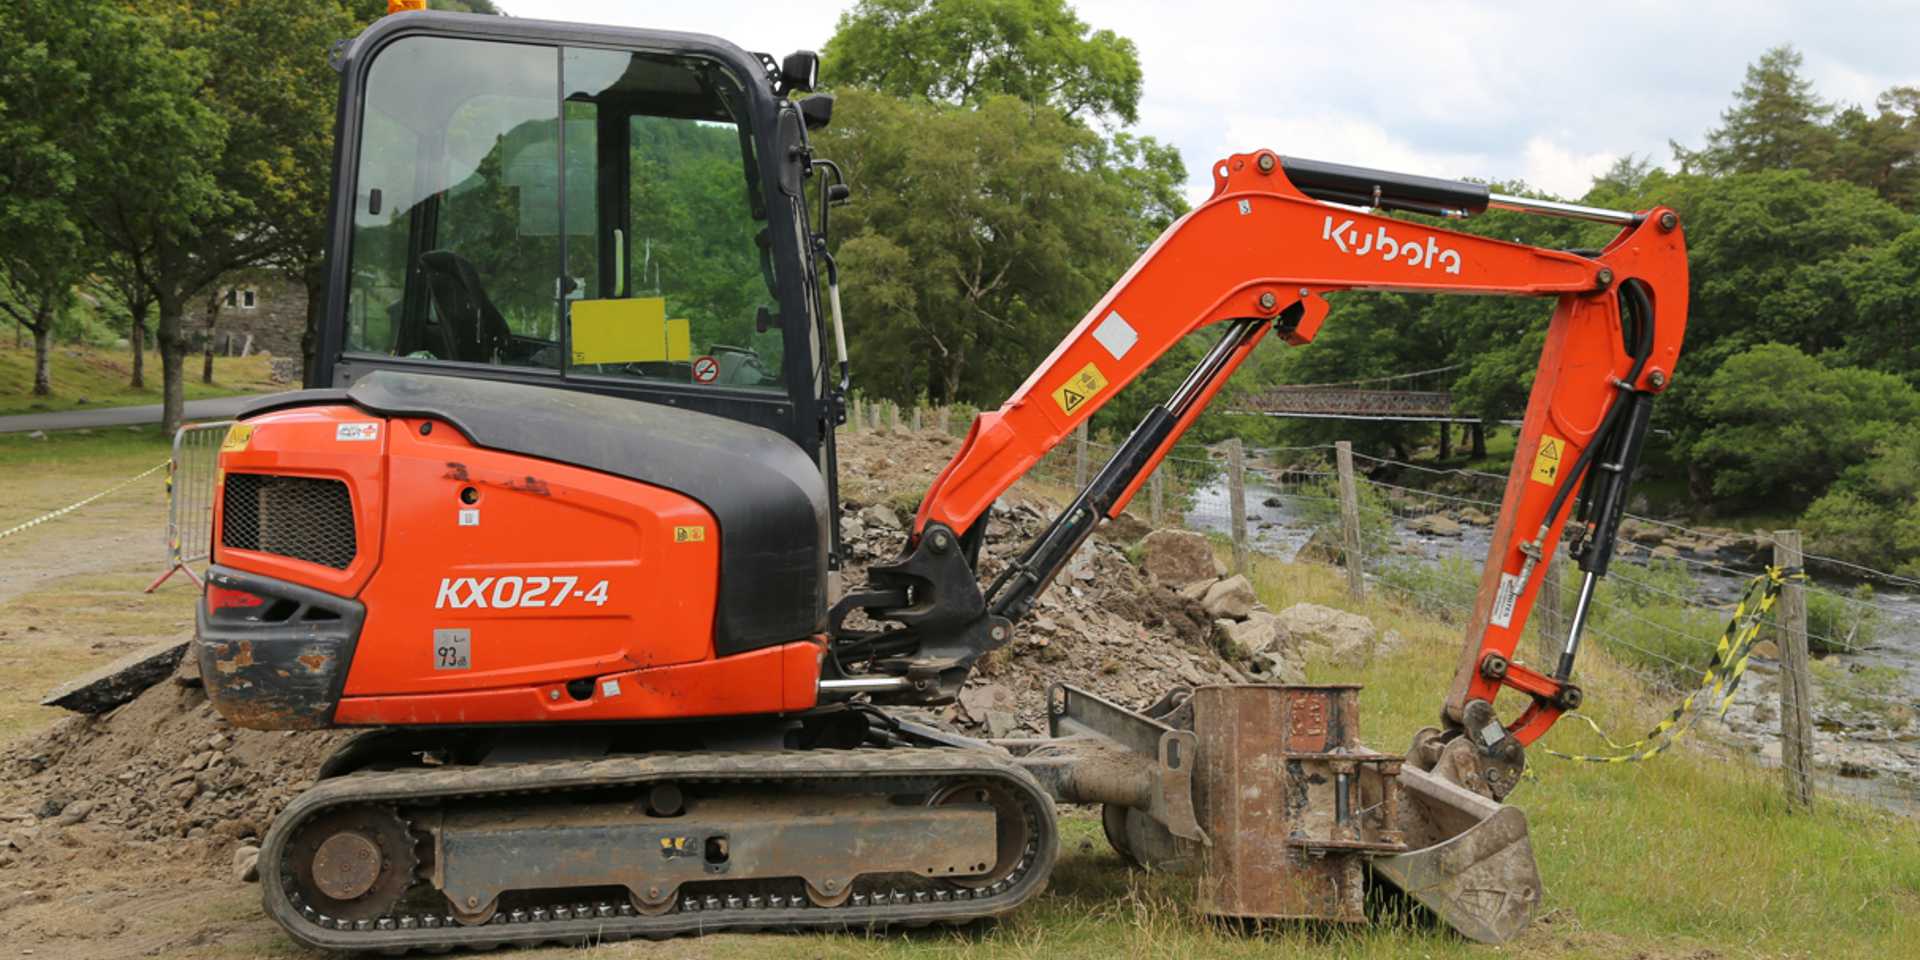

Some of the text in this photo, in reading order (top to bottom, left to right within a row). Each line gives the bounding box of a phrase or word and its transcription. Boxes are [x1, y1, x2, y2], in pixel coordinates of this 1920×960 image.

[1323, 216, 1461, 274] Kubota
[435, 576, 608, 608] KX027-4
[438, 646, 457, 667] 93
